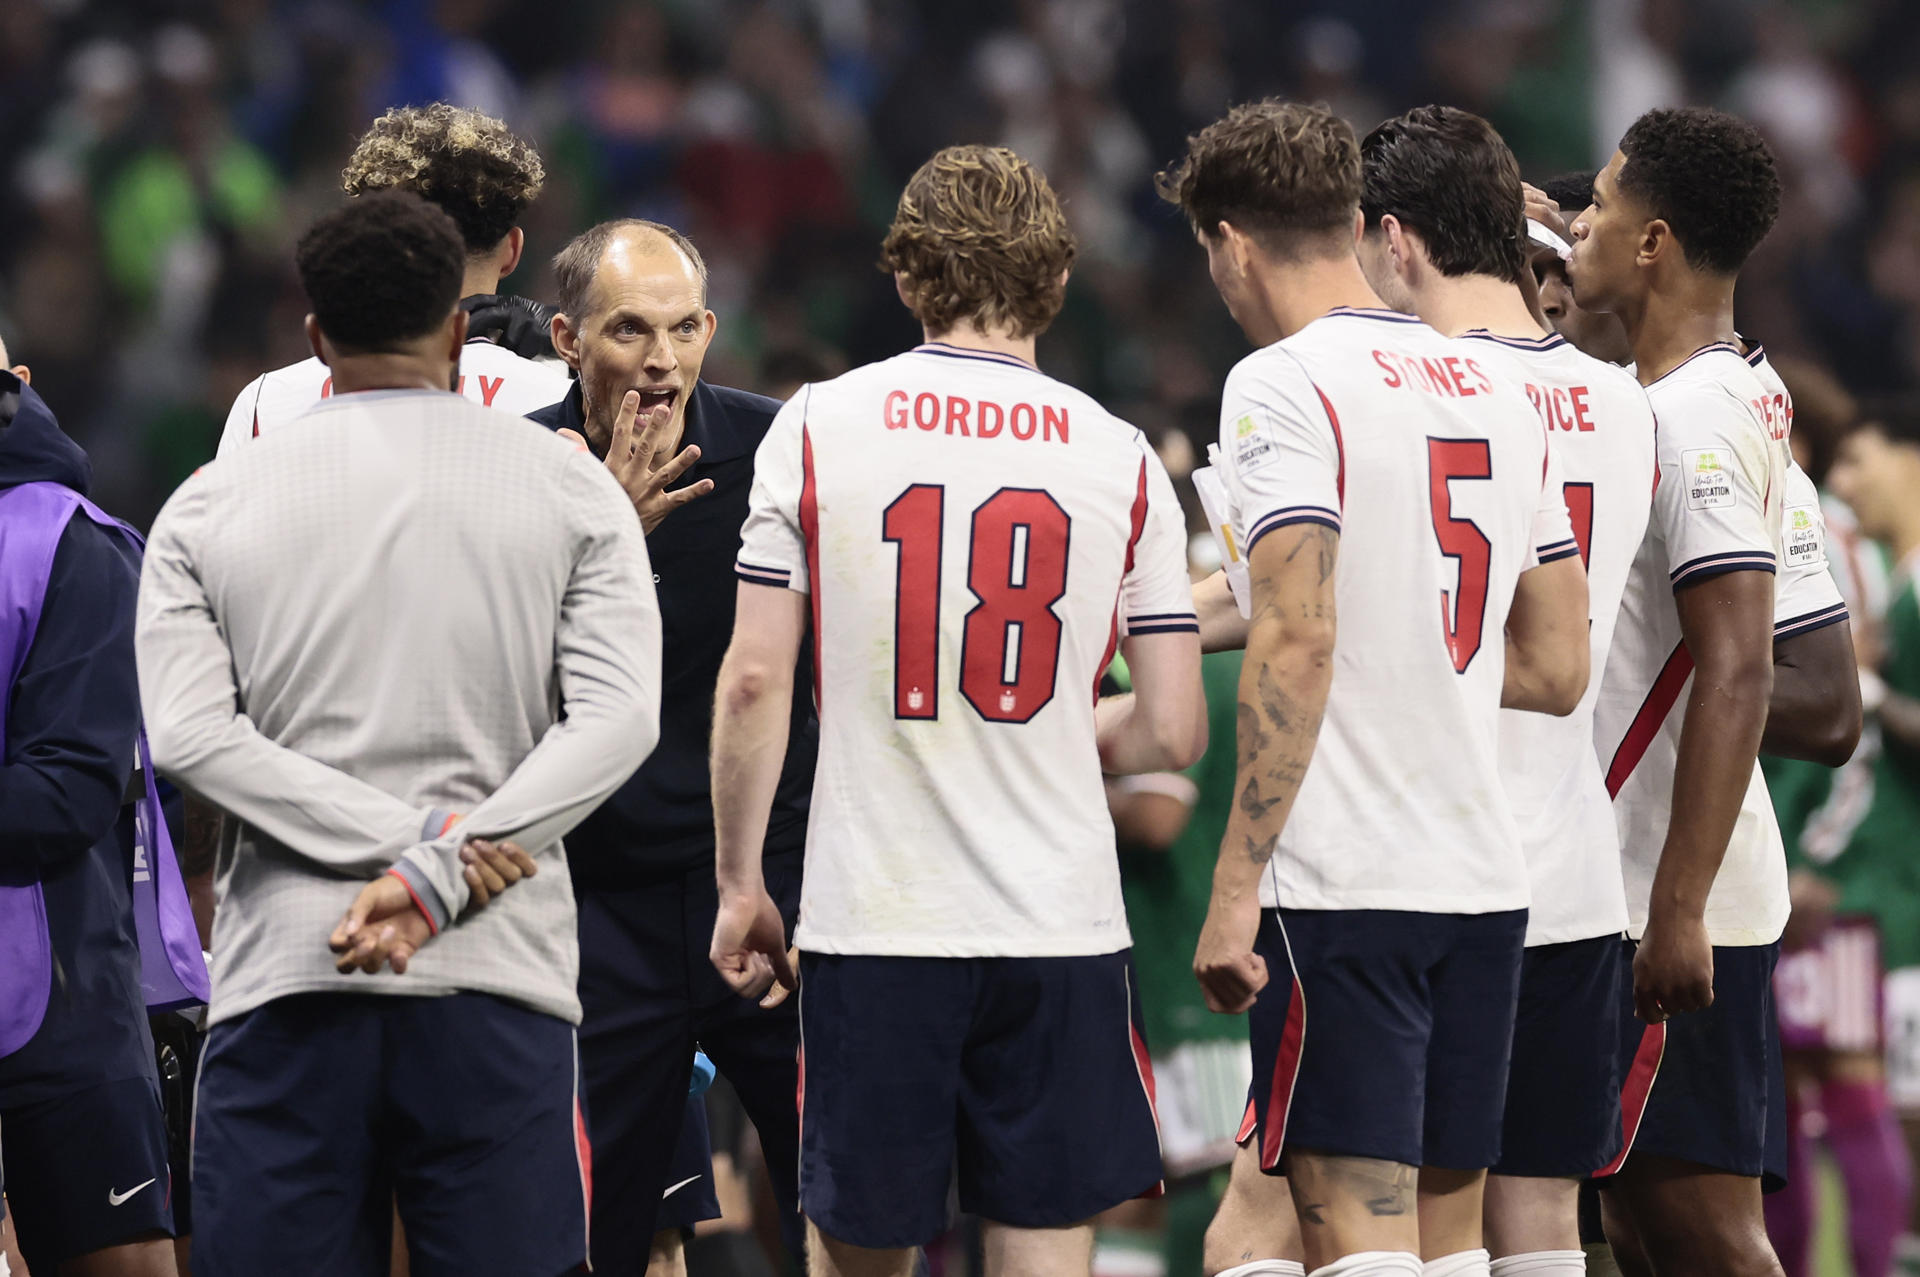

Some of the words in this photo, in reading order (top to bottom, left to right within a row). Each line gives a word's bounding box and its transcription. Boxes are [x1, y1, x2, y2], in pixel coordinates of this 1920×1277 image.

[1371, 349, 1494, 398] STONES
[883, 389, 1070, 445] GORDON
[1691, 486, 1730, 499] EDUCATION
[1426, 435, 1493, 675] 5
[882, 483, 1072, 725] 18
